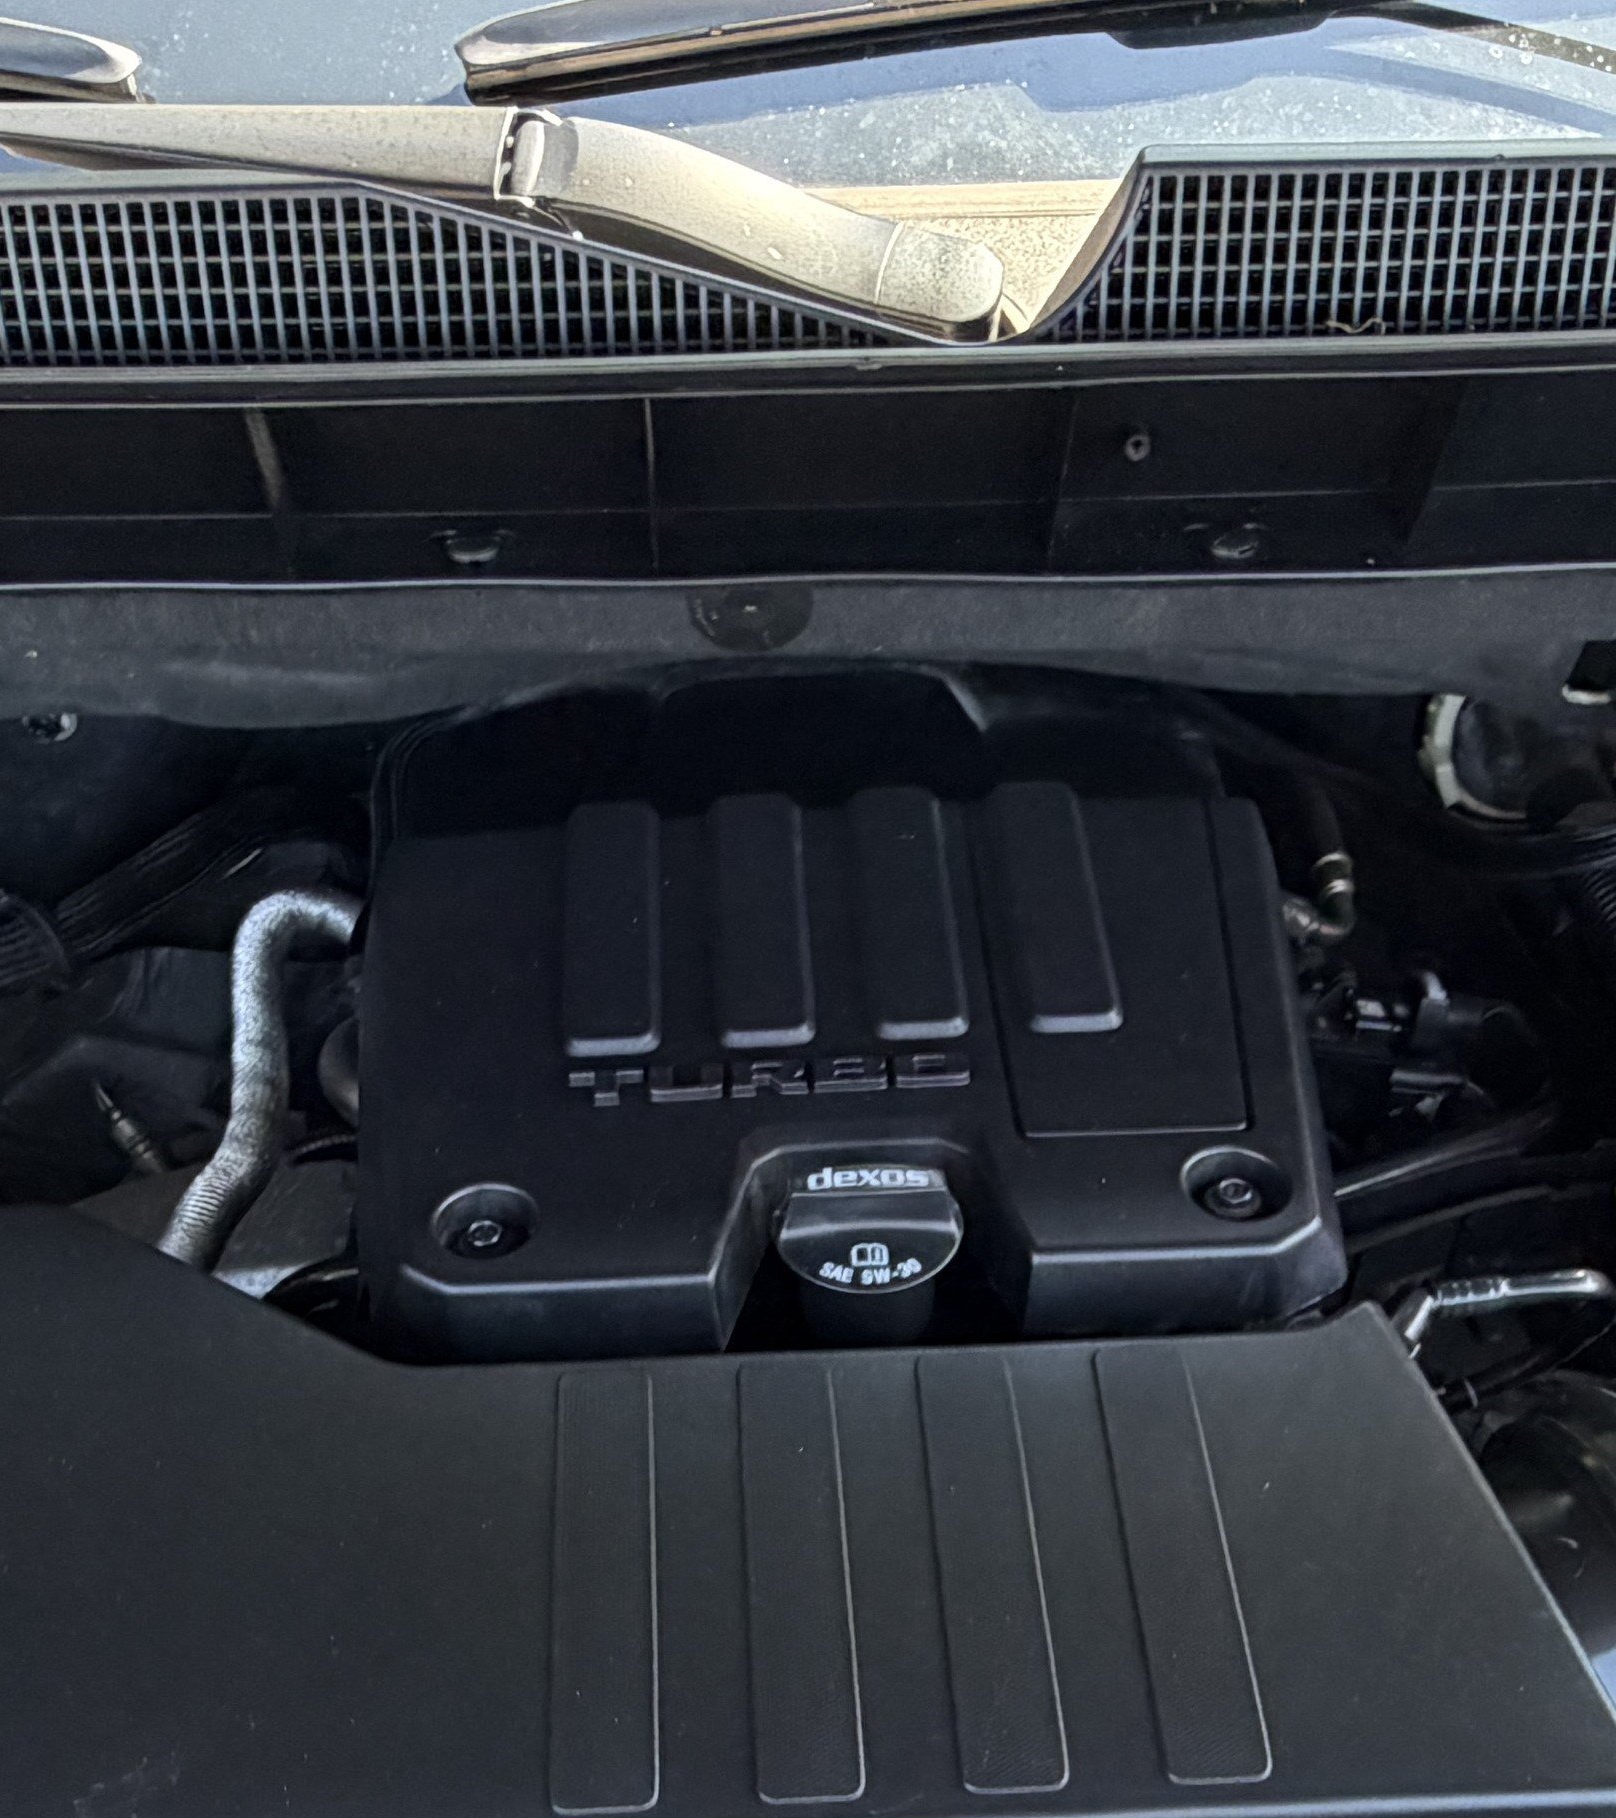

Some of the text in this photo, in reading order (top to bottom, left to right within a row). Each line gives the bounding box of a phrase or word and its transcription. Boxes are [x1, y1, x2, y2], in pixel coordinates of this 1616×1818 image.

[569, 1055, 971, 1107] TURBO
[807, 1166, 930, 1191] dexos
[818, 1261, 855, 1284] SAE
